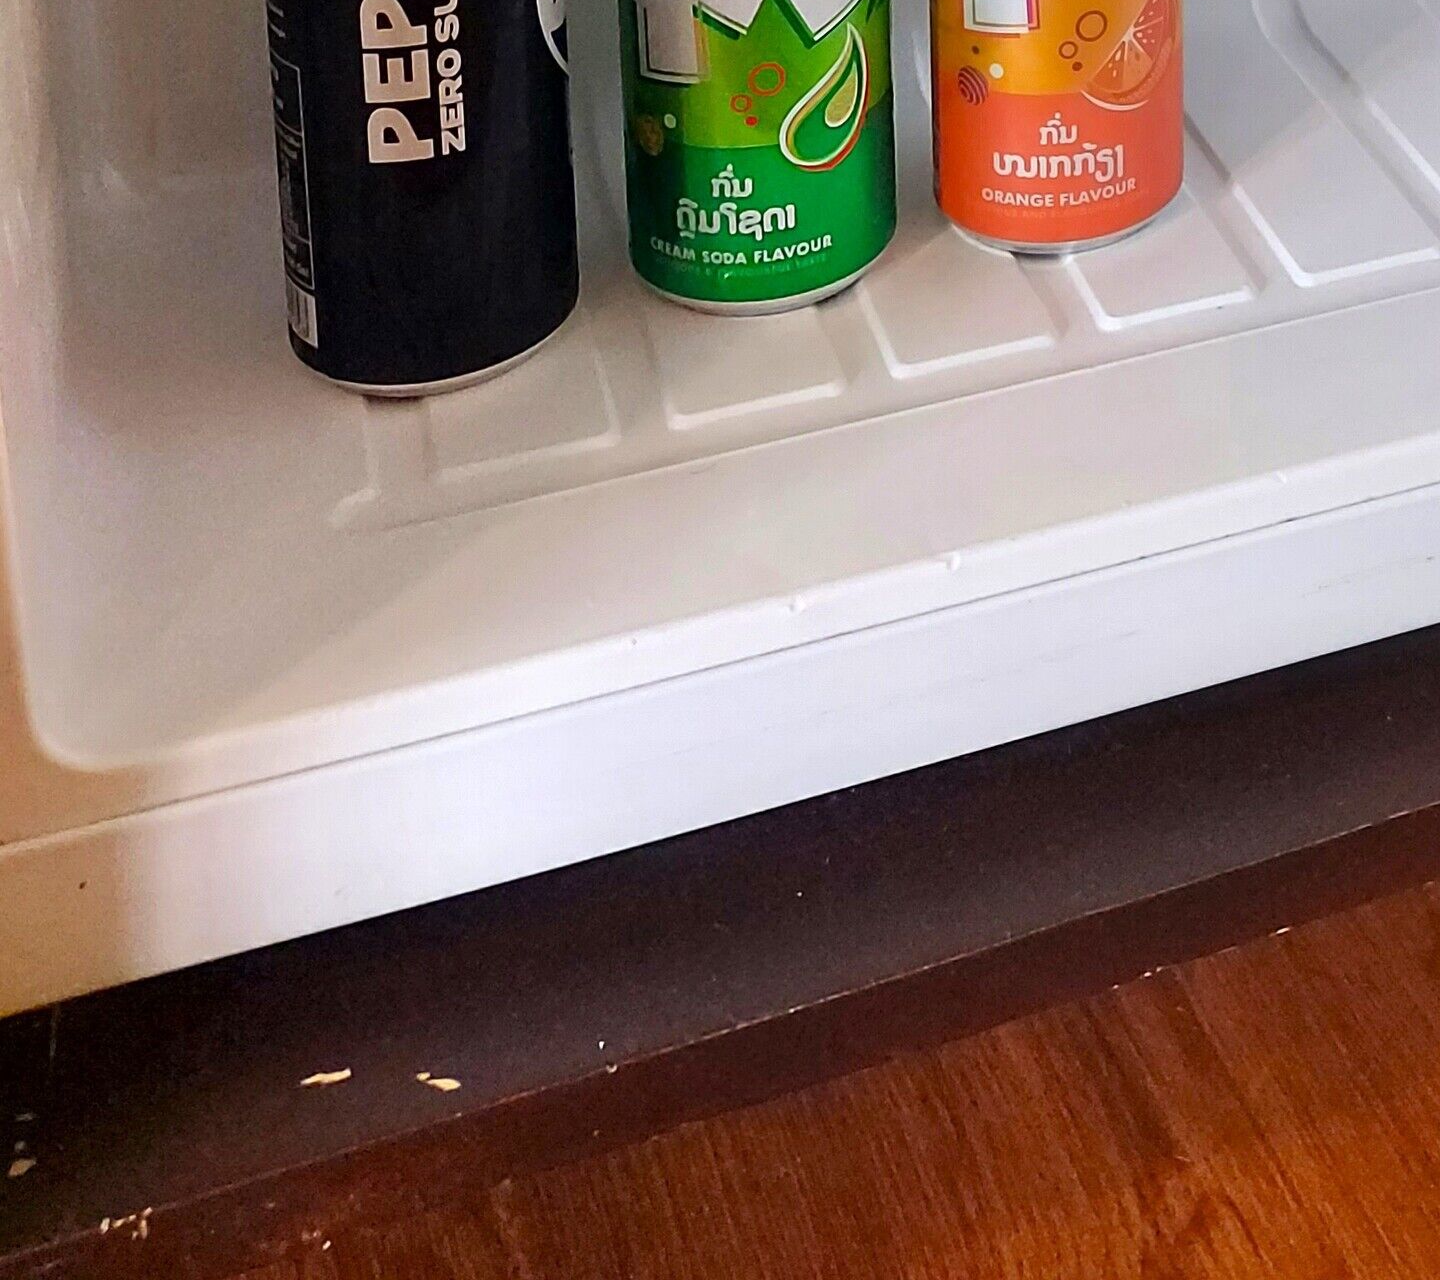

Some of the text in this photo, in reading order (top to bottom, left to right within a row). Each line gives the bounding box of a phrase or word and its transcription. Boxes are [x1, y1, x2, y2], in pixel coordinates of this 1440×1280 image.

[436, 47, 467, 156] ZERO
[981, 177, 1137, 208] ORANGE FLAVOUR
[650, 234, 833, 265] CREAM SODA FLAVOUR
